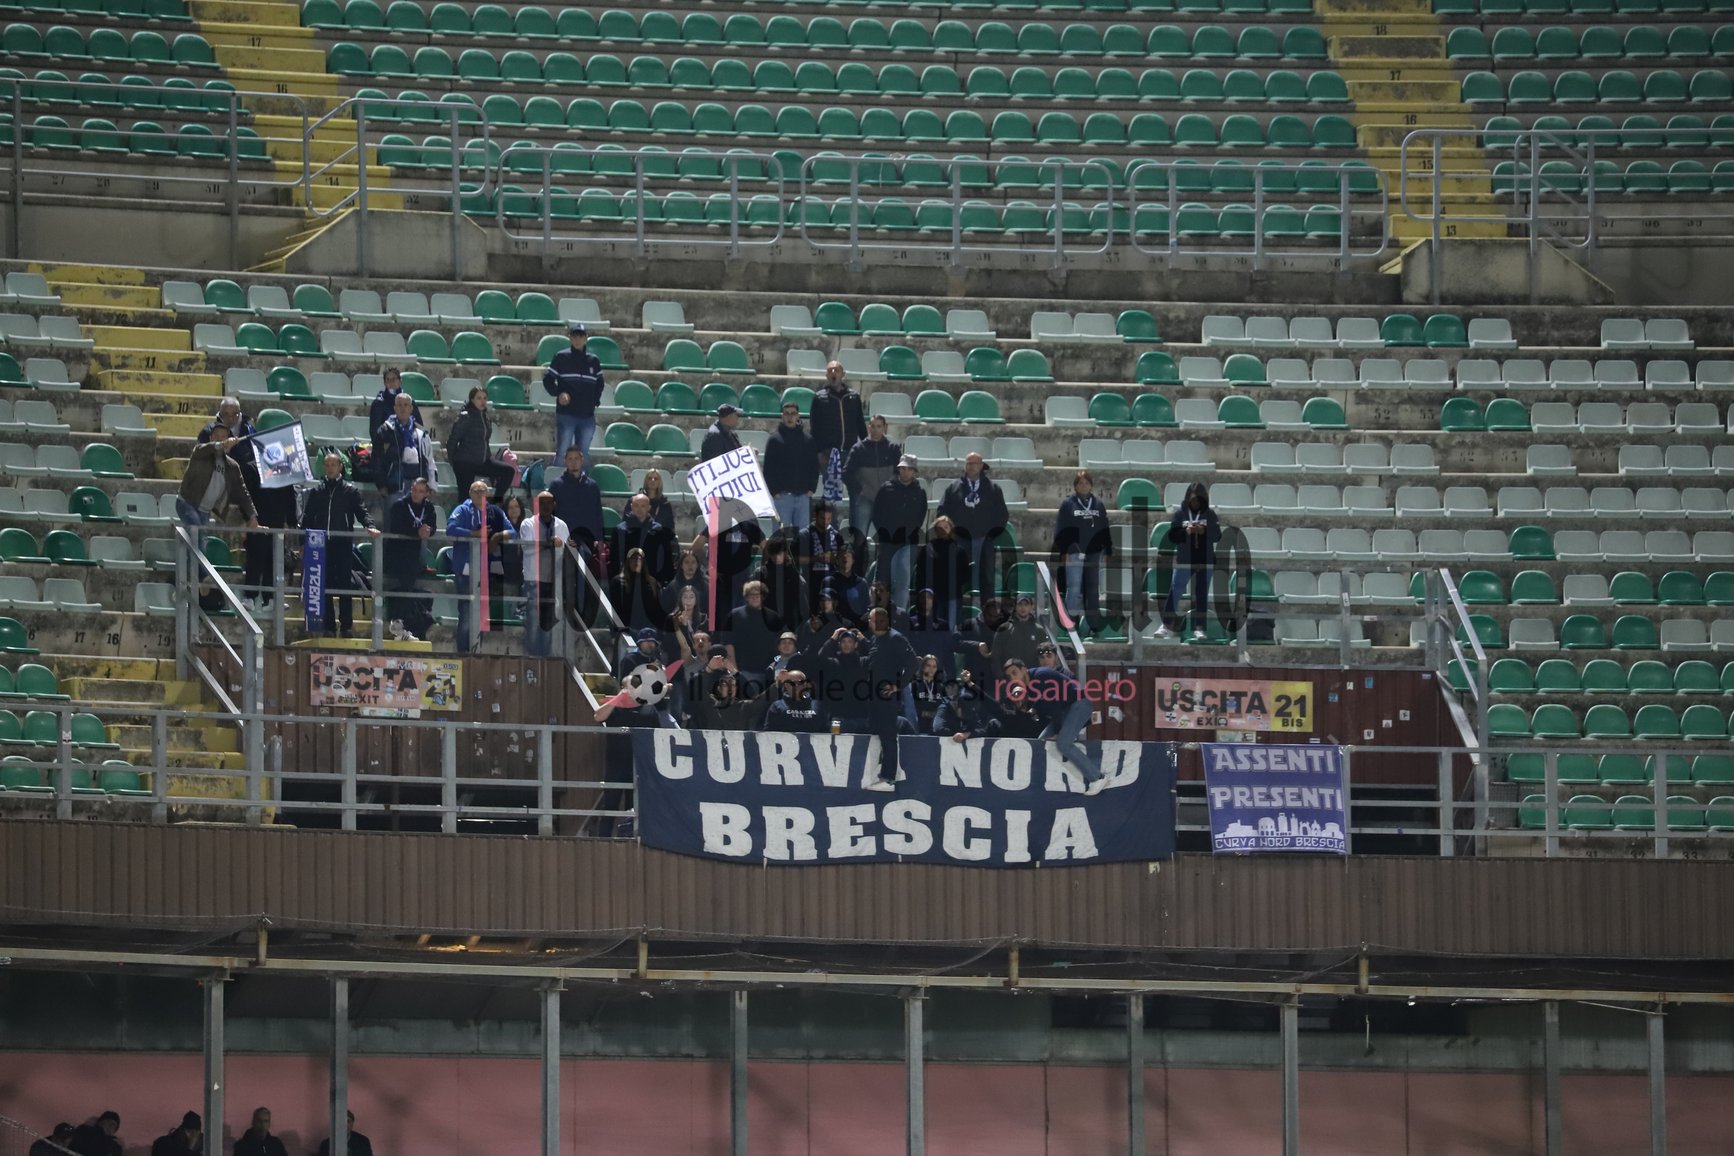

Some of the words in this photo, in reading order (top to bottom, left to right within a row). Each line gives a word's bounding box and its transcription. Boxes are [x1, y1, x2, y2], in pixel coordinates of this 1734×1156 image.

[1390, 70, 1401, 80] 17
[1405, 115, 1417, 125] 16
[1446, 225, 1457, 236] 13
[308, 564, 322, 616] TRENT
[74, 631, 86, 644] 17
[107, 633, 119, 646] 16
[313, 664, 417, 692] USCITA
[1157, 688, 1267, 714] USCITA
[1274, 694, 1307, 718] 21
[1281, 718, 1304, 728] BIS
[939, 736, 1143, 794] NORD
[1212, 748, 1336, 774] ASSENTI
[1210, 785, 1345, 811] PRESENTI
[698, 798, 1100, 864] BRESCIA
[1215, 837, 1256, 849] CURVA
[1260, 837, 1291, 848] NORD
[1295, 837, 1345, 850] BRESCIA
